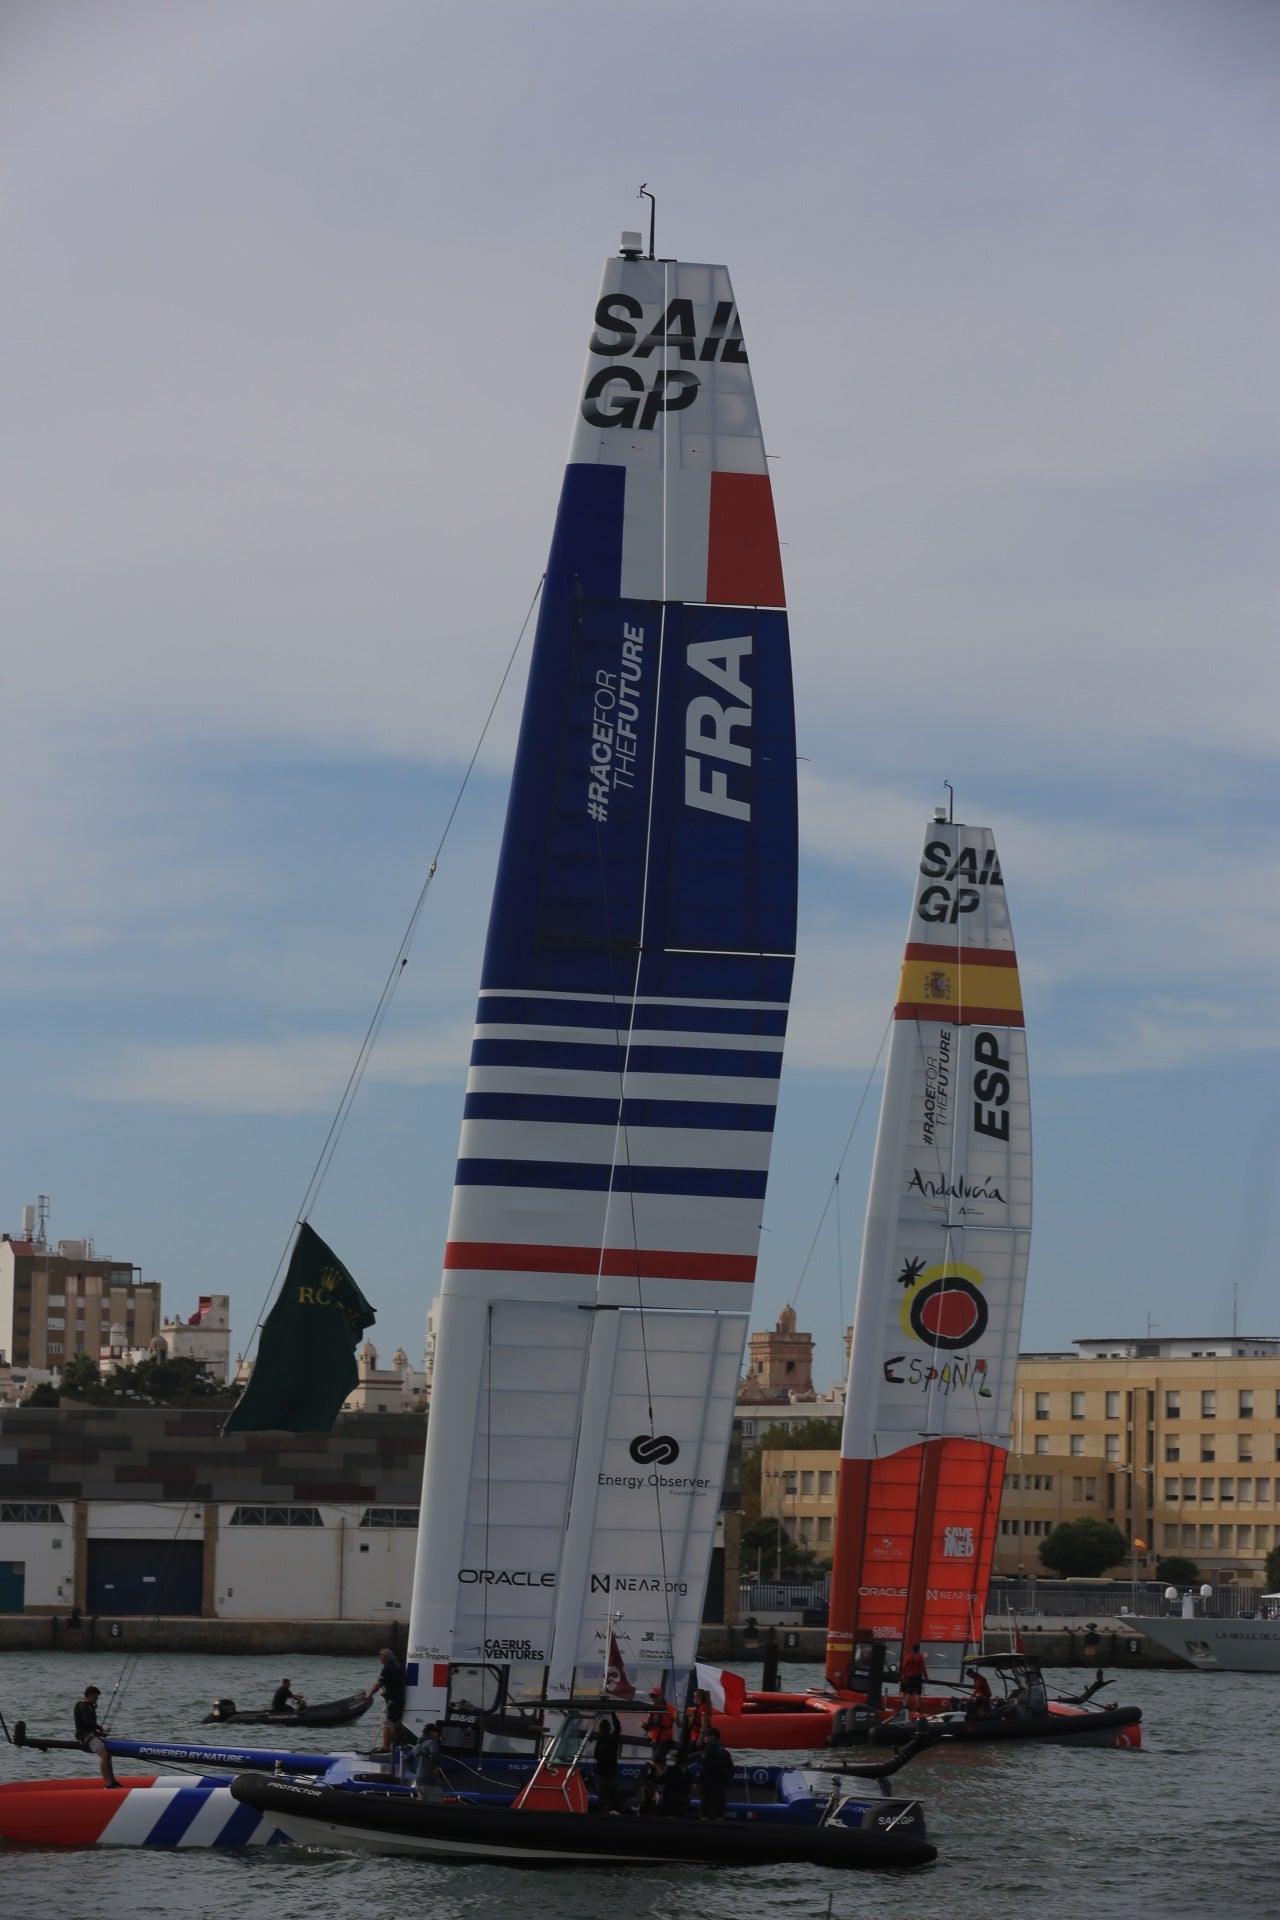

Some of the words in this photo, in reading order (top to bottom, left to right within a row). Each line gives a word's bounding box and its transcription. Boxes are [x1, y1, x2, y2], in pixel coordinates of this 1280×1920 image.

[590, 293, 749, 364] SAIL
[581, 365, 701, 430] GP
[685, 635, 753, 822] FRA
[919, 841, 1004, 886] SAIL
[917, 886, 980, 924] GP
[973, 1031, 1010, 1142] ESP
[598, 1473, 644, 1489] Energy
[648, 1475, 711, 1488] Observer
[944, 1526, 974, 1541] SAVE
[943, 1539, 975, 1557] MED
[458, 1569, 556, 1587] ORACLE
[858, 1587, 909, 1597] ORACLE
[484, 1639, 531, 1650] CAERUS
[1130, 1640, 1137, 1652] 9
[484, 1649, 544, 1660] VENTURES
[450, 1714, 476, 1723] B&G
[139, 1747, 187, 1759] POWERED
[188, 1751, 203, 1760] BY
[202, 1752, 245, 1763] NATURE
